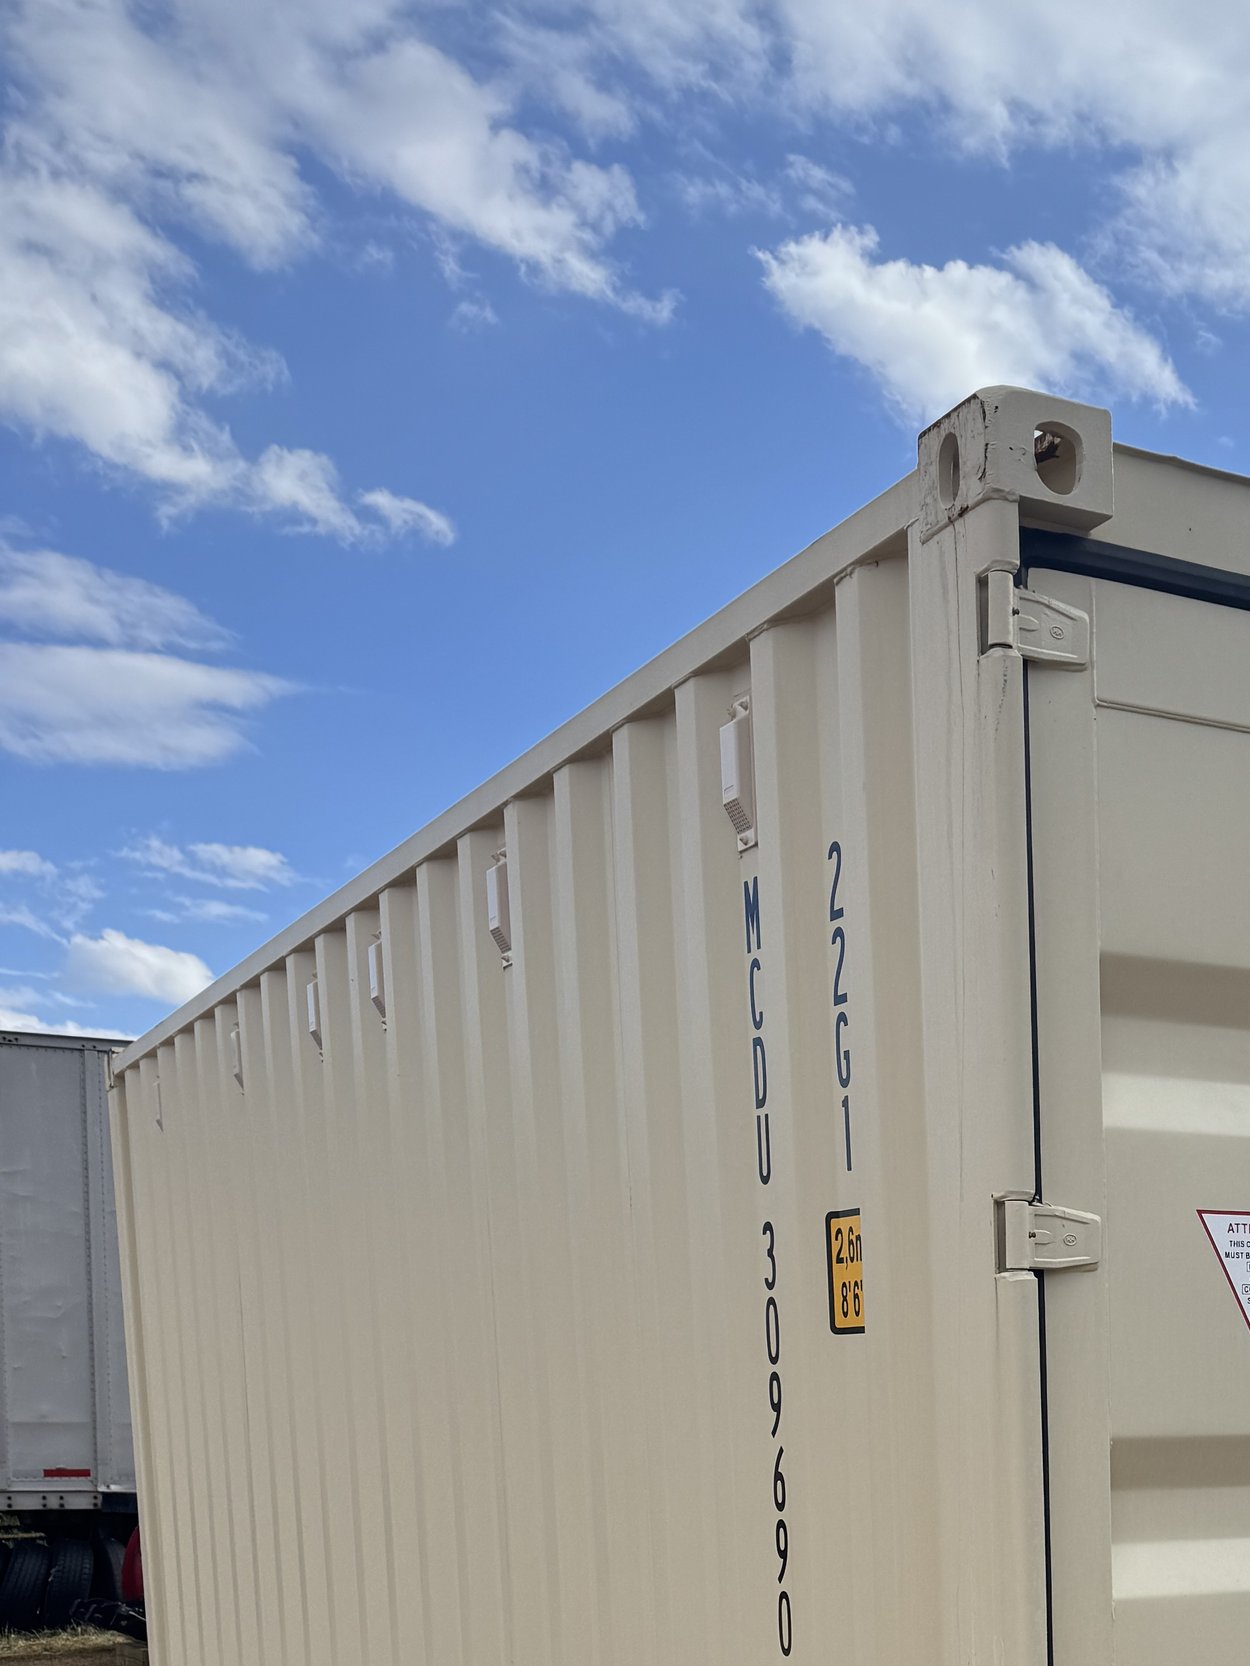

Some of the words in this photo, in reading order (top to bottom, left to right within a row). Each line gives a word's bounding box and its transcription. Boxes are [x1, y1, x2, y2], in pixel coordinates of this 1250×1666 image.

[828, 841, 852, 1171] 22G1
[744, 876, 771, 1185] MCDU
[762, 1221, 793, 1657] 309690
[1224, 1251, 1244, 1260] MUST
[1229, 1240, 1245, 1248] THIS
